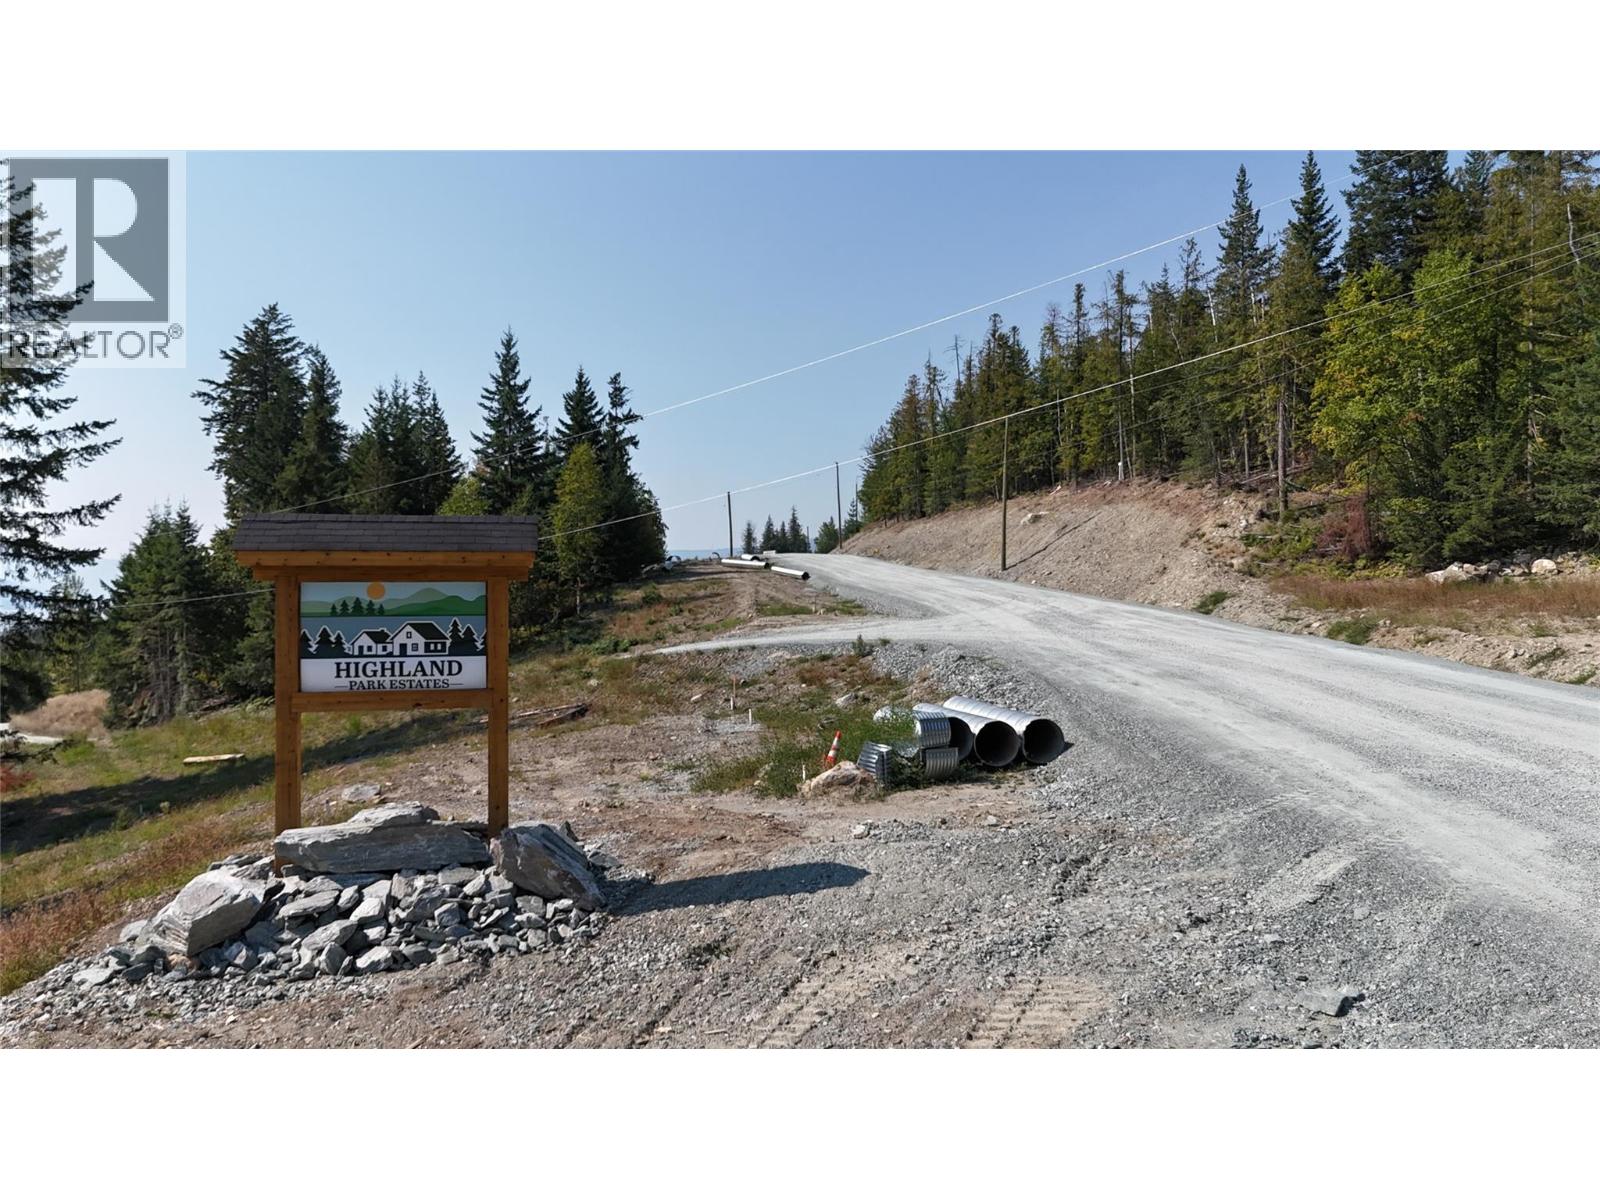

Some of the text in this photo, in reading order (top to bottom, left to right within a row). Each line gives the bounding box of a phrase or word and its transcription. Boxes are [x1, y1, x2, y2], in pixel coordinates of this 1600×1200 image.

[334, 660, 462, 678] HIGHLAND
[349, 679, 450, 690] PARK ESTATES
